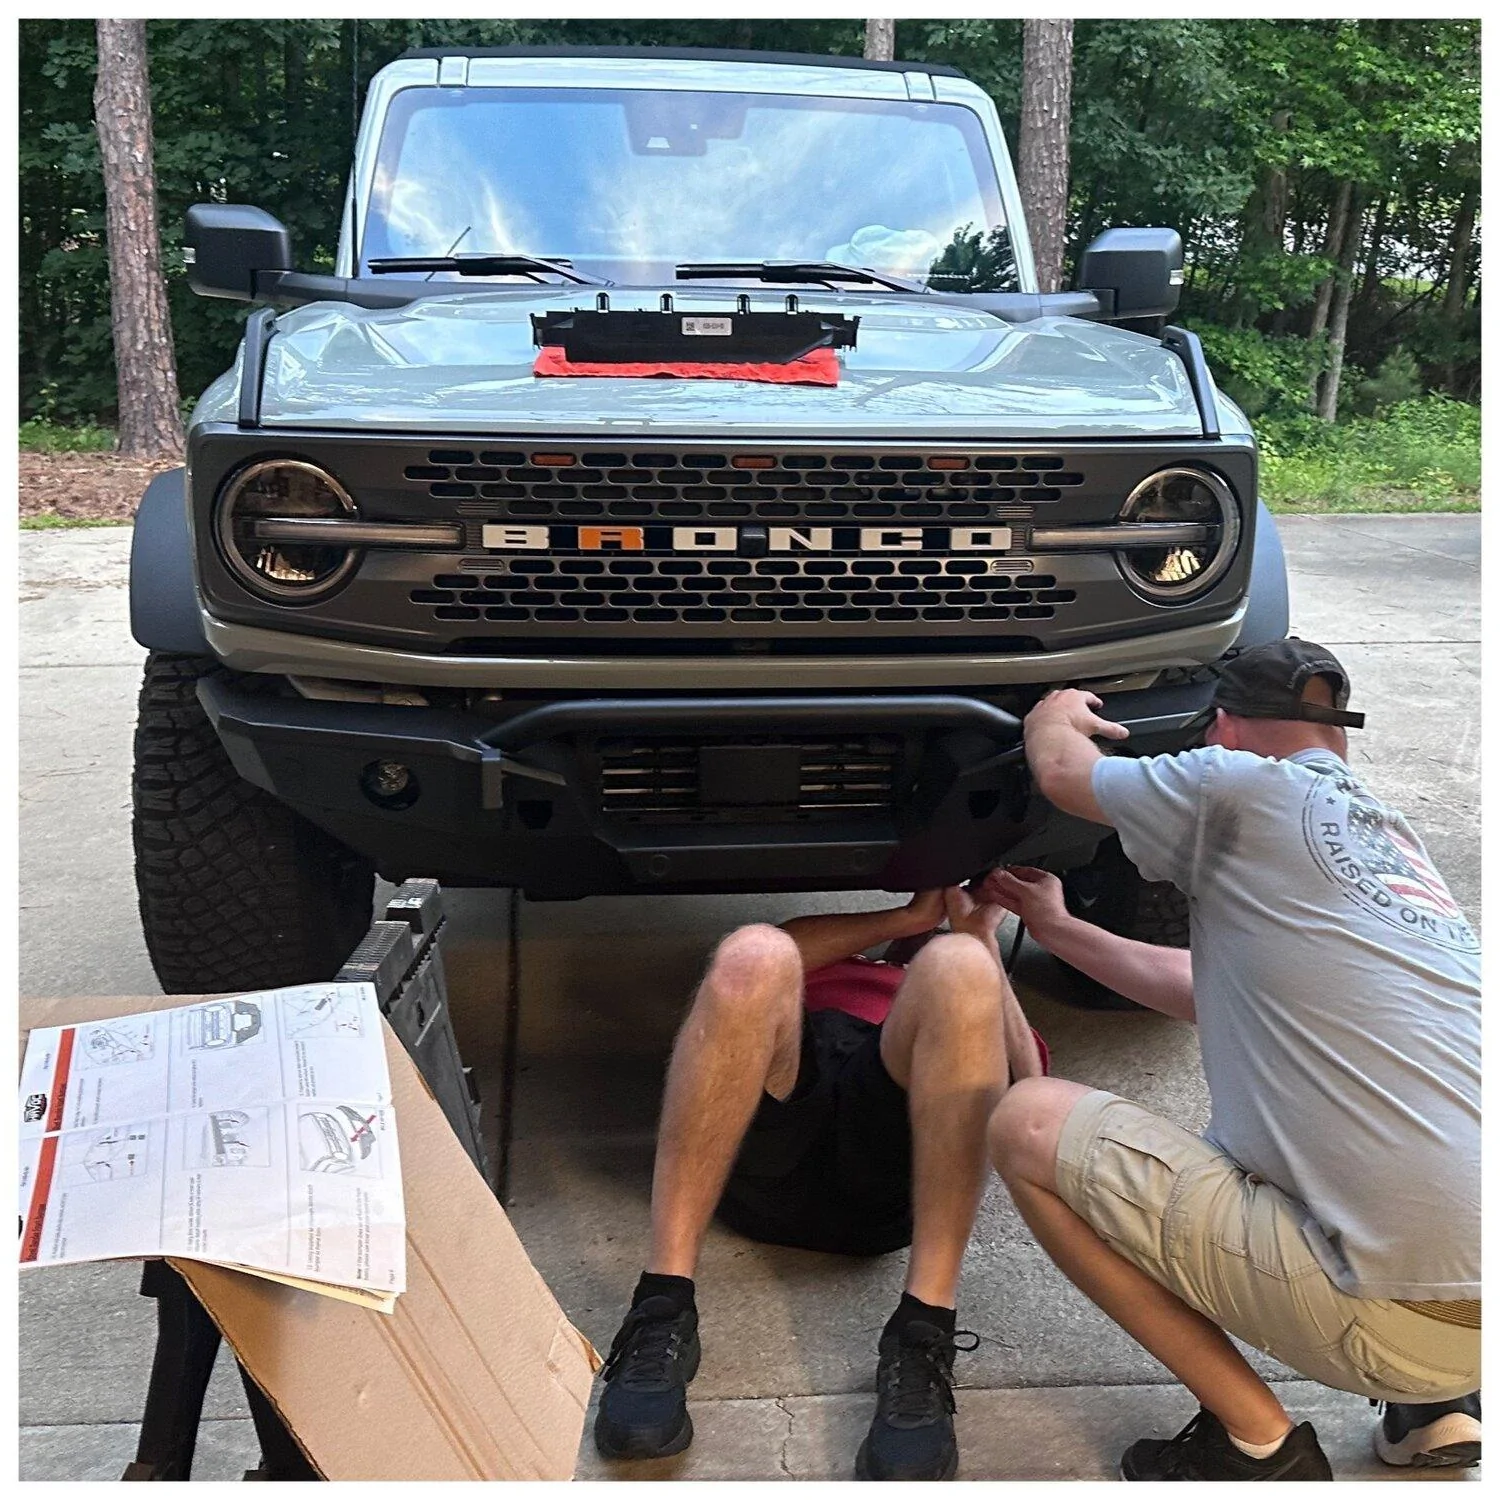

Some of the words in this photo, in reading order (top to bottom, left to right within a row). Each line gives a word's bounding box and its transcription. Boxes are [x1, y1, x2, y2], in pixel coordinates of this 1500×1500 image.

[481, 523, 1013, 551] BRONCO
[1319, 821, 1393, 909] RAISED
[1400, 906, 1437, 933] ON
